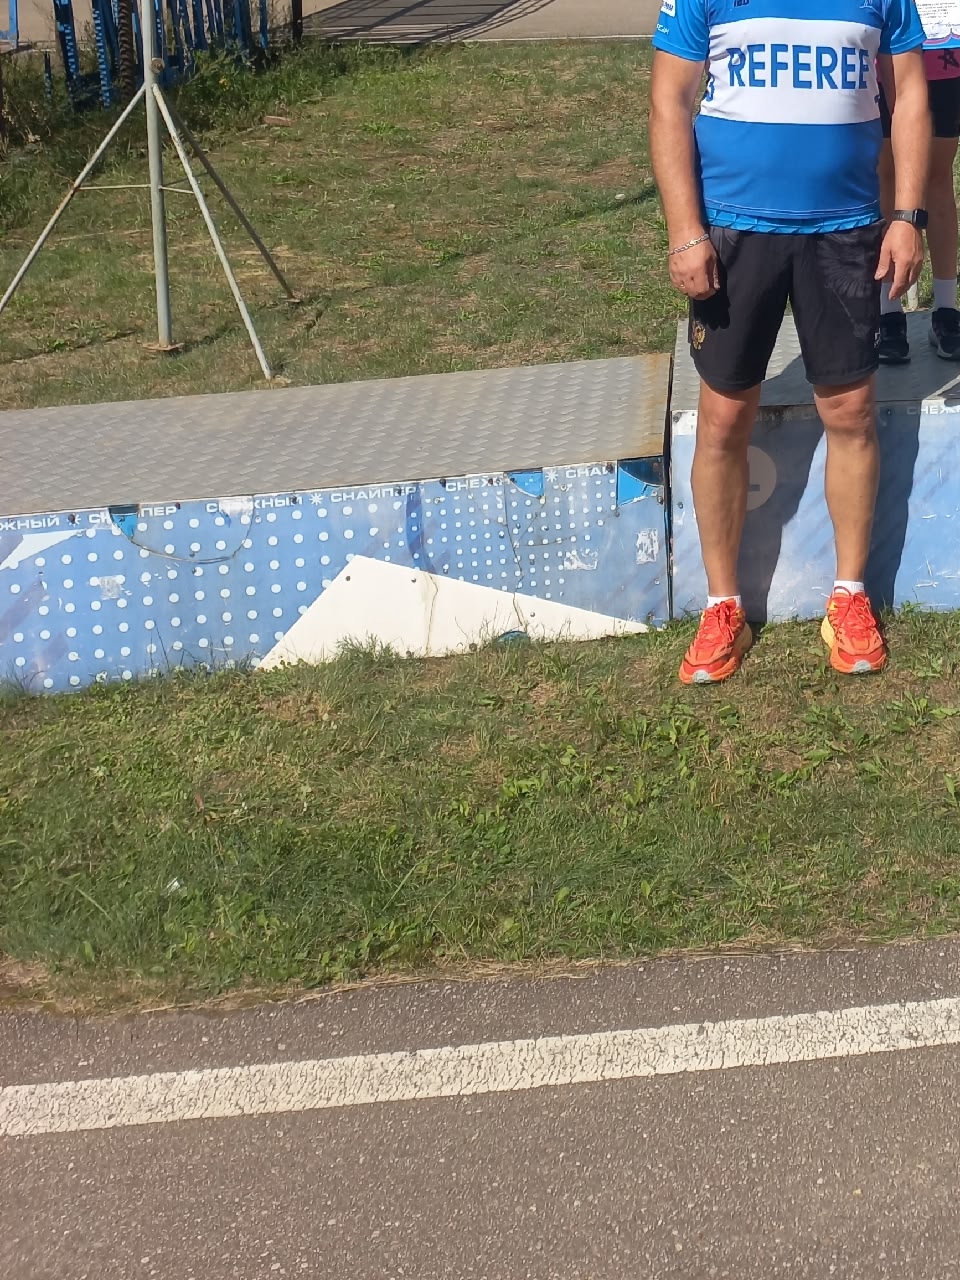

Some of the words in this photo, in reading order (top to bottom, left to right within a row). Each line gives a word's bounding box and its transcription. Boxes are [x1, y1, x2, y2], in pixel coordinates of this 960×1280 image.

[726, 43, 870, 90] REFEREE
[0, 515, 60, 531] ЖНЫЙ
[330, 485, 417, 503] СНАЙПЕР
